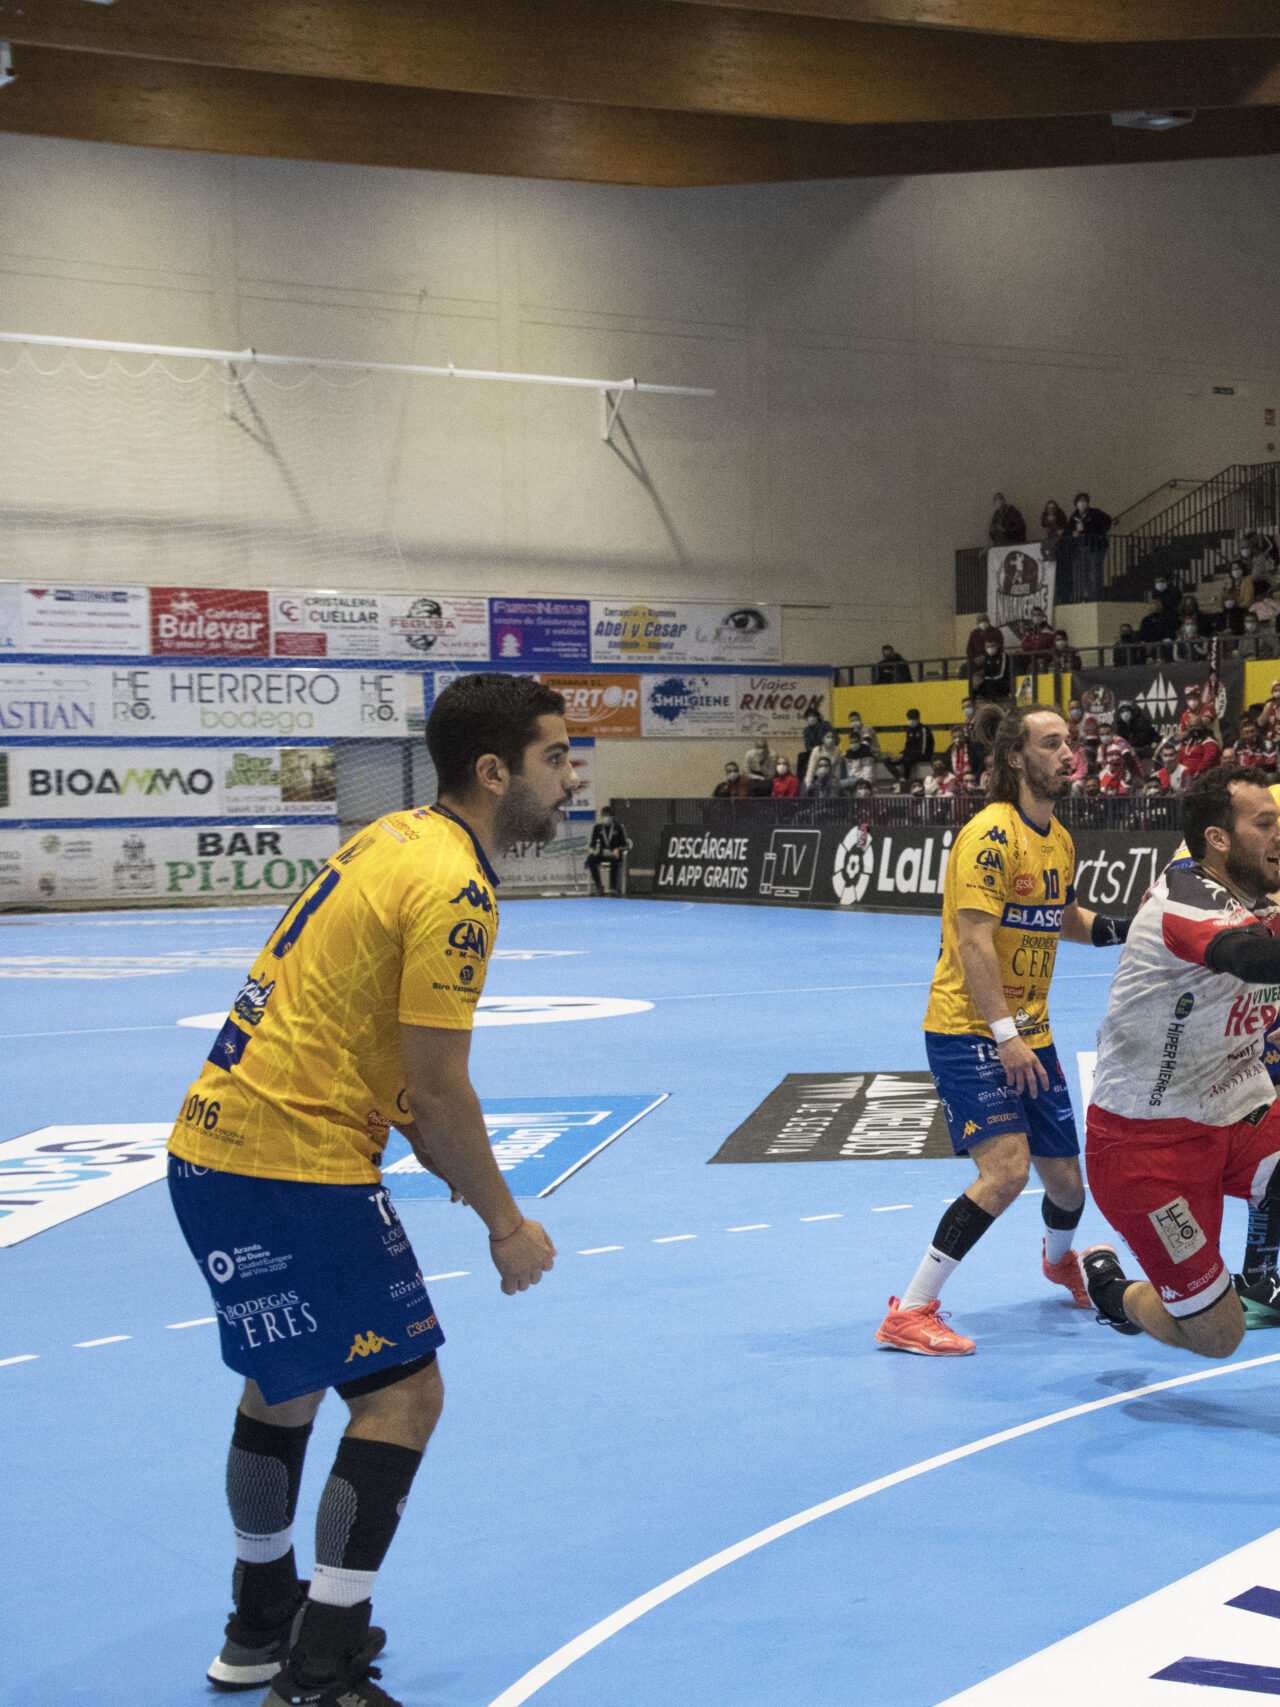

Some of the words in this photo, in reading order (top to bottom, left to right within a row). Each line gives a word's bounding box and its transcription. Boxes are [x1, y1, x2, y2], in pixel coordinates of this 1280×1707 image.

[159, 614, 264, 640] Bulevar
[594, 621, 627, 637] Abel
[631, 624, 640, 638] y
[170, 673, 339, 704] HERRERO
[751, 678, 798, 693] Viajes
[200, 706, 314, 733] bodega
[198, 832, 282, 857] BAR
[668, 832, 749, 860] DESCÁRGATE
[782, 844, 807, 876] TV
[877, 830, 952, 894] LaLi
[658, 865, 674, 886] LA
[676, 866, 702, 887] APP
[704, 867, 749, 889] GRATIS
[1014, 878, 1034, 890] gsk
[1043, 869, 1060, 900] 10
[1163, 1022, 1185, 1060] HIPER
[1149, 1059, 1177, 1107] HIERROS
[186, 1094, 221, 1131] 016
[765, 1116, 834, 1154] SEGOVIA
[839, 1098, 940, 1156] CONGELADOS
[234, 1244, 262, 1255] Aranda
[236, 1255, 247, 1263] de
[247, 1251, 271, 1261] Duero
[238, 1260, 263, 1271] Ciudad
[264, 1254, 293, 1266] Europea
[240, 1270, 252, 1279] del
[253, 1267, 268, 1275] Vino
[269, 1262, 288, 1272] 2020
[226, 1290, 300, 1319] BODEGAS
